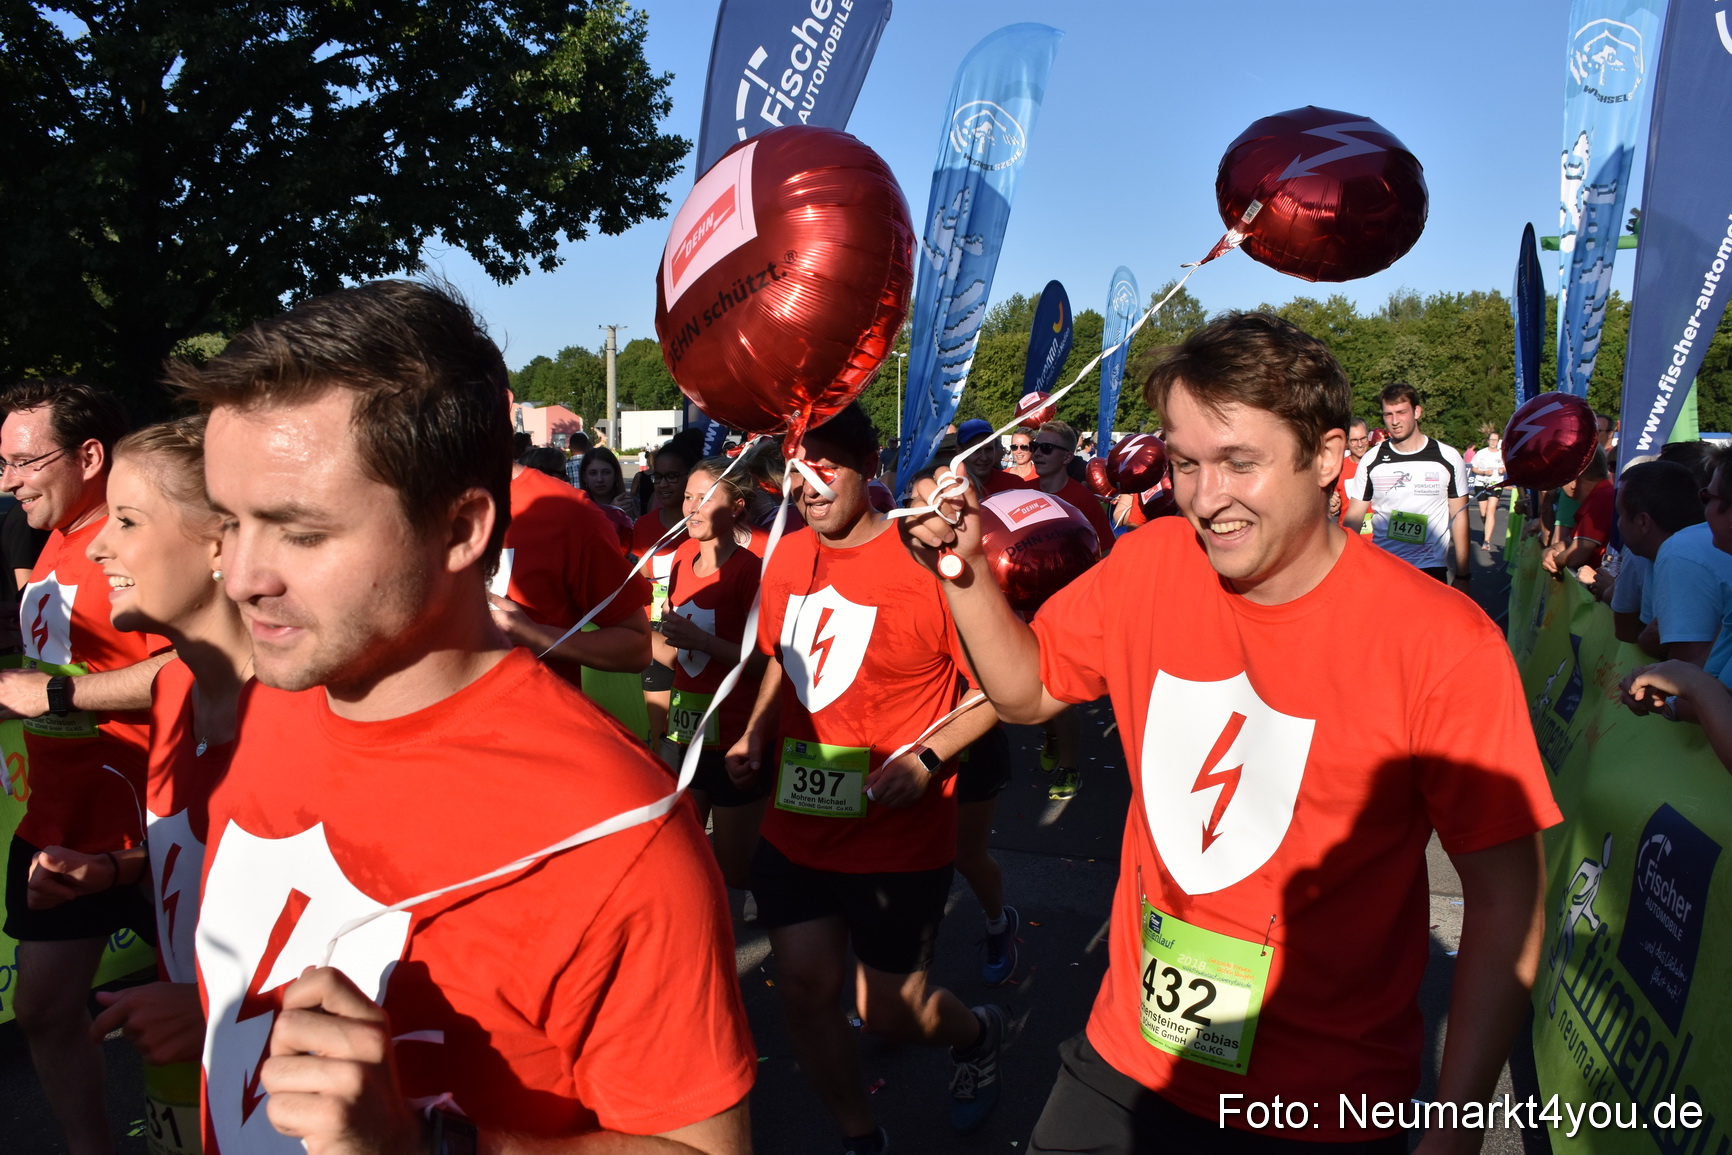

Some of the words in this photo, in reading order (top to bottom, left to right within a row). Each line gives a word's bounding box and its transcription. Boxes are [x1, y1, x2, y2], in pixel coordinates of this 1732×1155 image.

[798, 0, 854, 125] AUTOMOBILE
[684, 211, 715, 259] DEHN
[1021, 501, 1040, 515] DEHN
[1393, 520, 1422, 535] 1479
[1005, 534, 1043, 558] DEHN
[673, 708, 702, 731] 407
[792, 766, 845, 797] 397
[791, 792, 816, 803] Mohren
[817, 796, 846, 806] Michael
[1644, 859, 1693, 923] Fischer
[1644, 896, 1684, 942] AUTOMOBILE
[1177, 953, 1207, 971] 2018
[1142, 957, 1217, 1027] 432
[1161, 1029, 1187, 1045] GmbH
[1193, 1041, 1226, 1057] Co.KG.
[1195, 1027, 1240, 1049] Tobias
[1557, 1009, 1615, 1101] neumarkt
